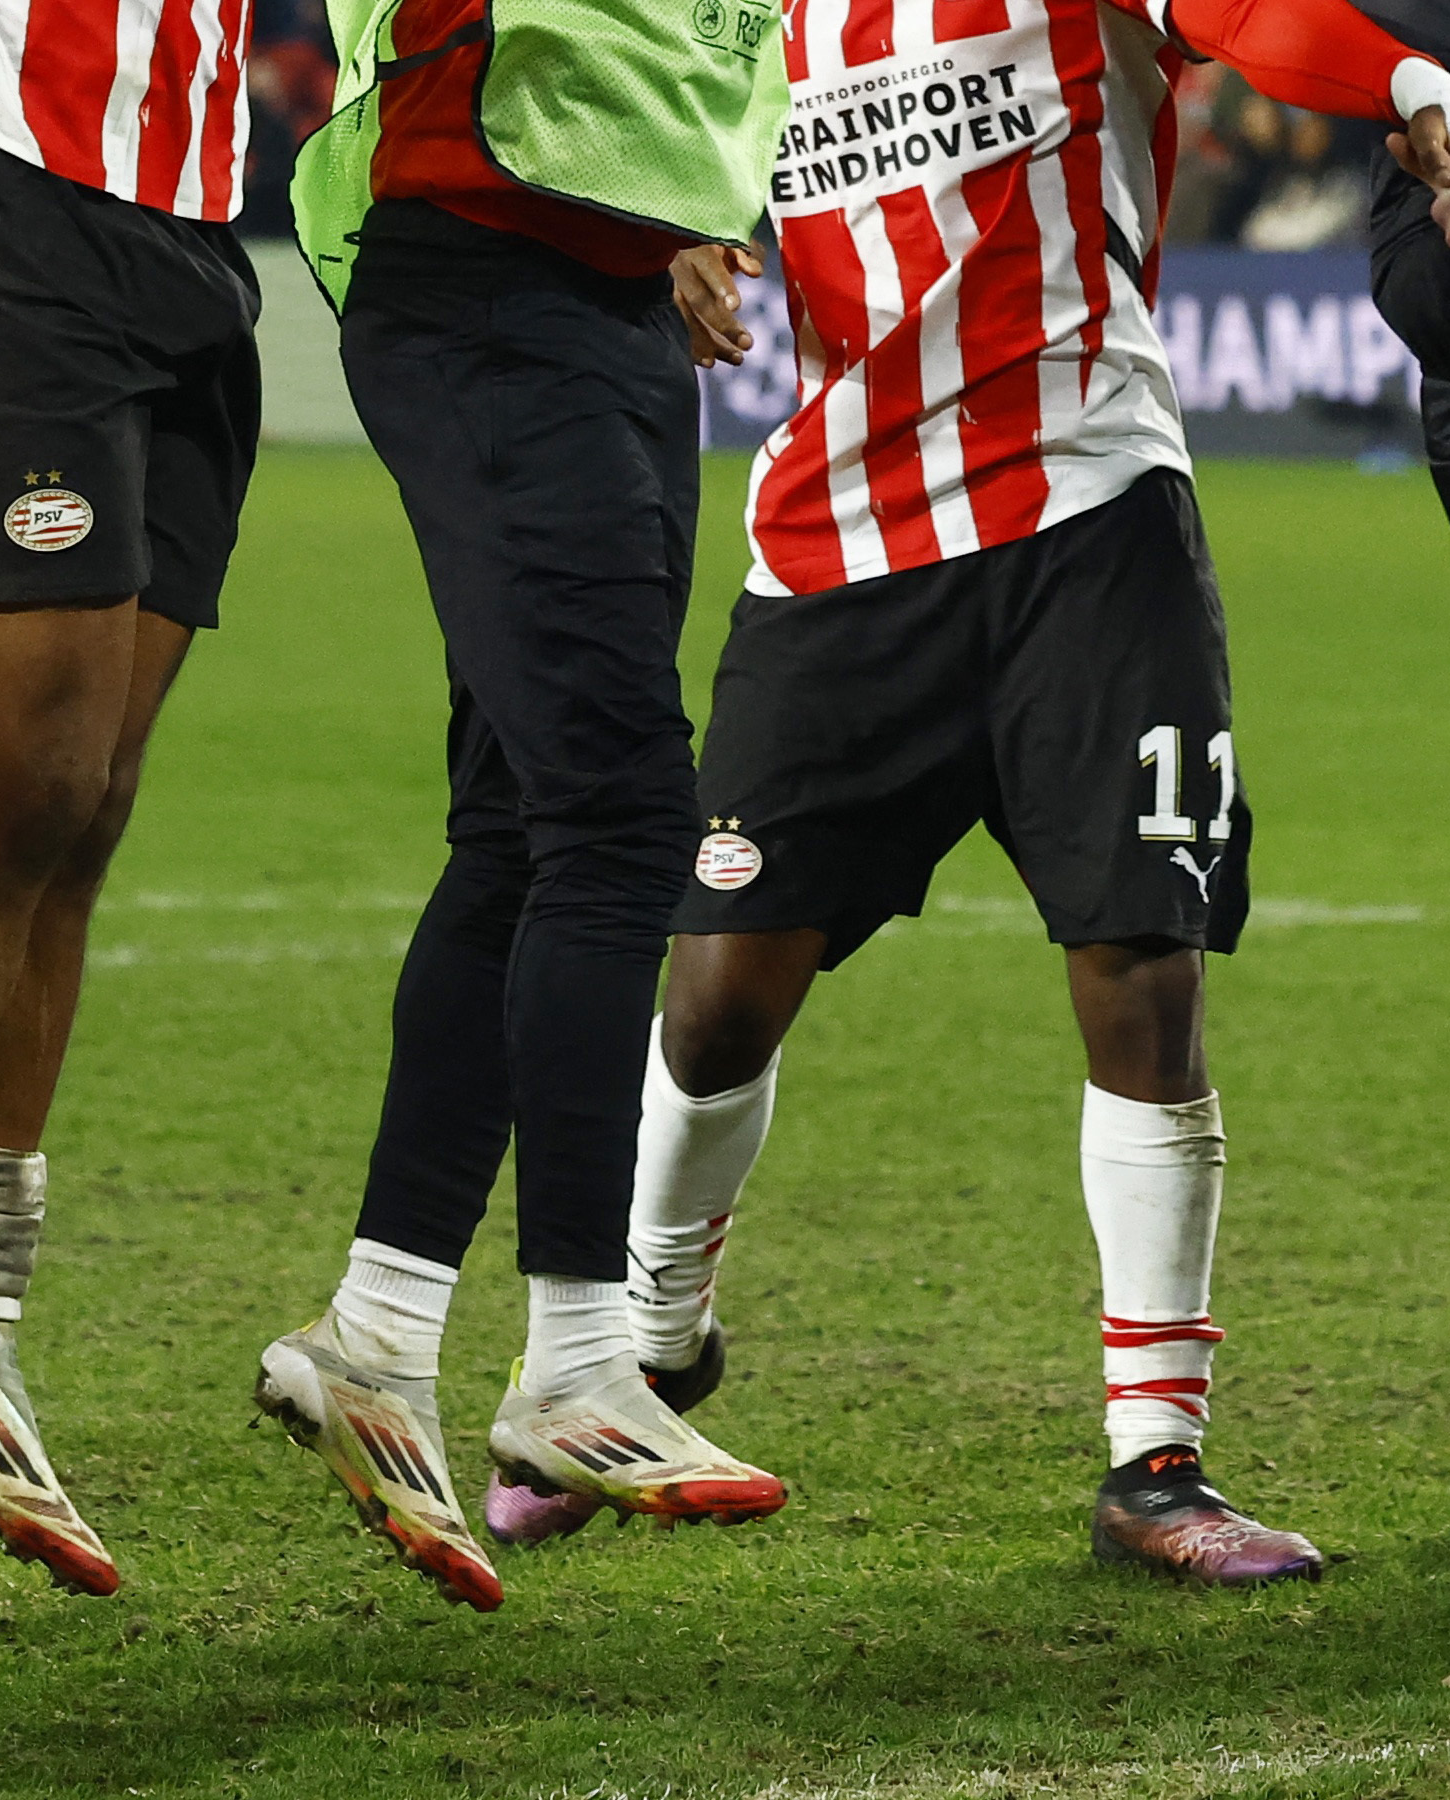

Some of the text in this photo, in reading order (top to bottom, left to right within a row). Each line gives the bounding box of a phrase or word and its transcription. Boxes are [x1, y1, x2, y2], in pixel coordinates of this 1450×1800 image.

[794, 58, 955, 113] METROPOOLREGIO
[770, 104, 1037, 203] EINDHOVEN
[34, 509, 63, 524] PSV
[1138, 725, 1234, 841] 11
[714, 853, 735, 864] PSV
